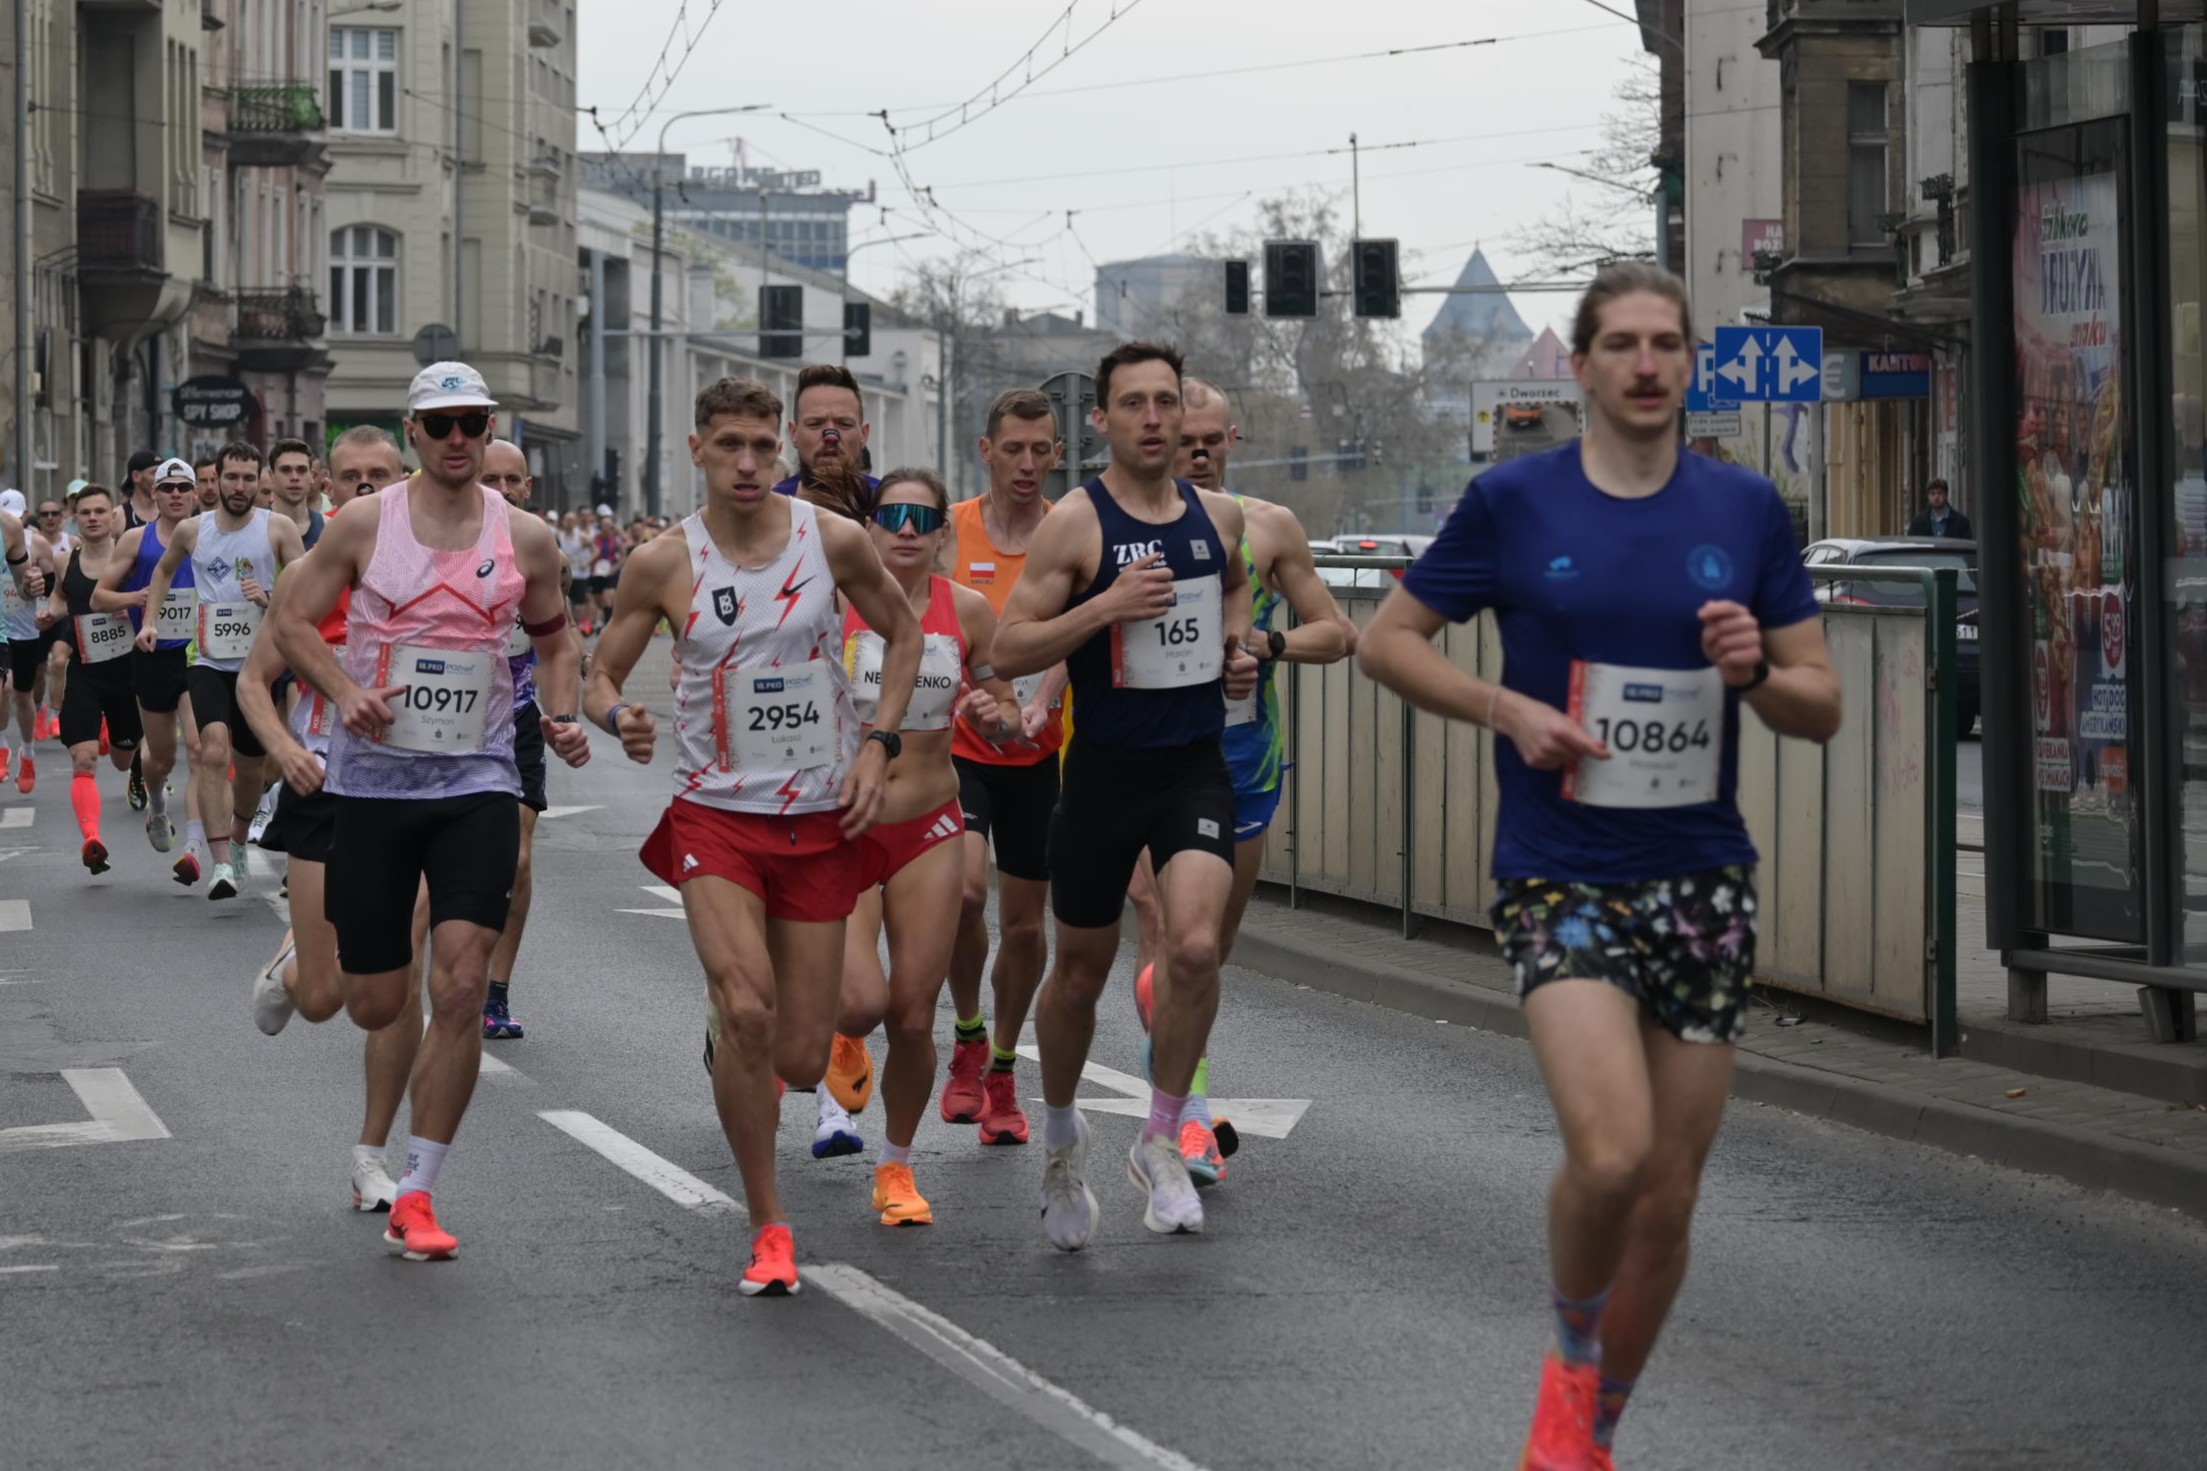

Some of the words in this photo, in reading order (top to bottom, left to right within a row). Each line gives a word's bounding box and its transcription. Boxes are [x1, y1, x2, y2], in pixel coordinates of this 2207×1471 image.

[1509, 387, 1560, 399] Dworzec
[183, 403, 207, 420] SPY
[210, 402, 241, 420] SHOP
[158, 606, 191, 620] 9017
[91, 625, 126, 644] 8885
[214, 622, 251, 637] 5996
[1154, 617, 1199, 646] 165
[756, 681, 782, 690] 18.PKO
[404, 684, 478, 713] 10917
[2109, 690, 2125, 706] DOG
[420, 715, 455, 726] Szymon
[747, 700, 820, 731] 2954
[771, 734, 802, 744] Łukasz
[1595, 717, 1710, 753] 10864
